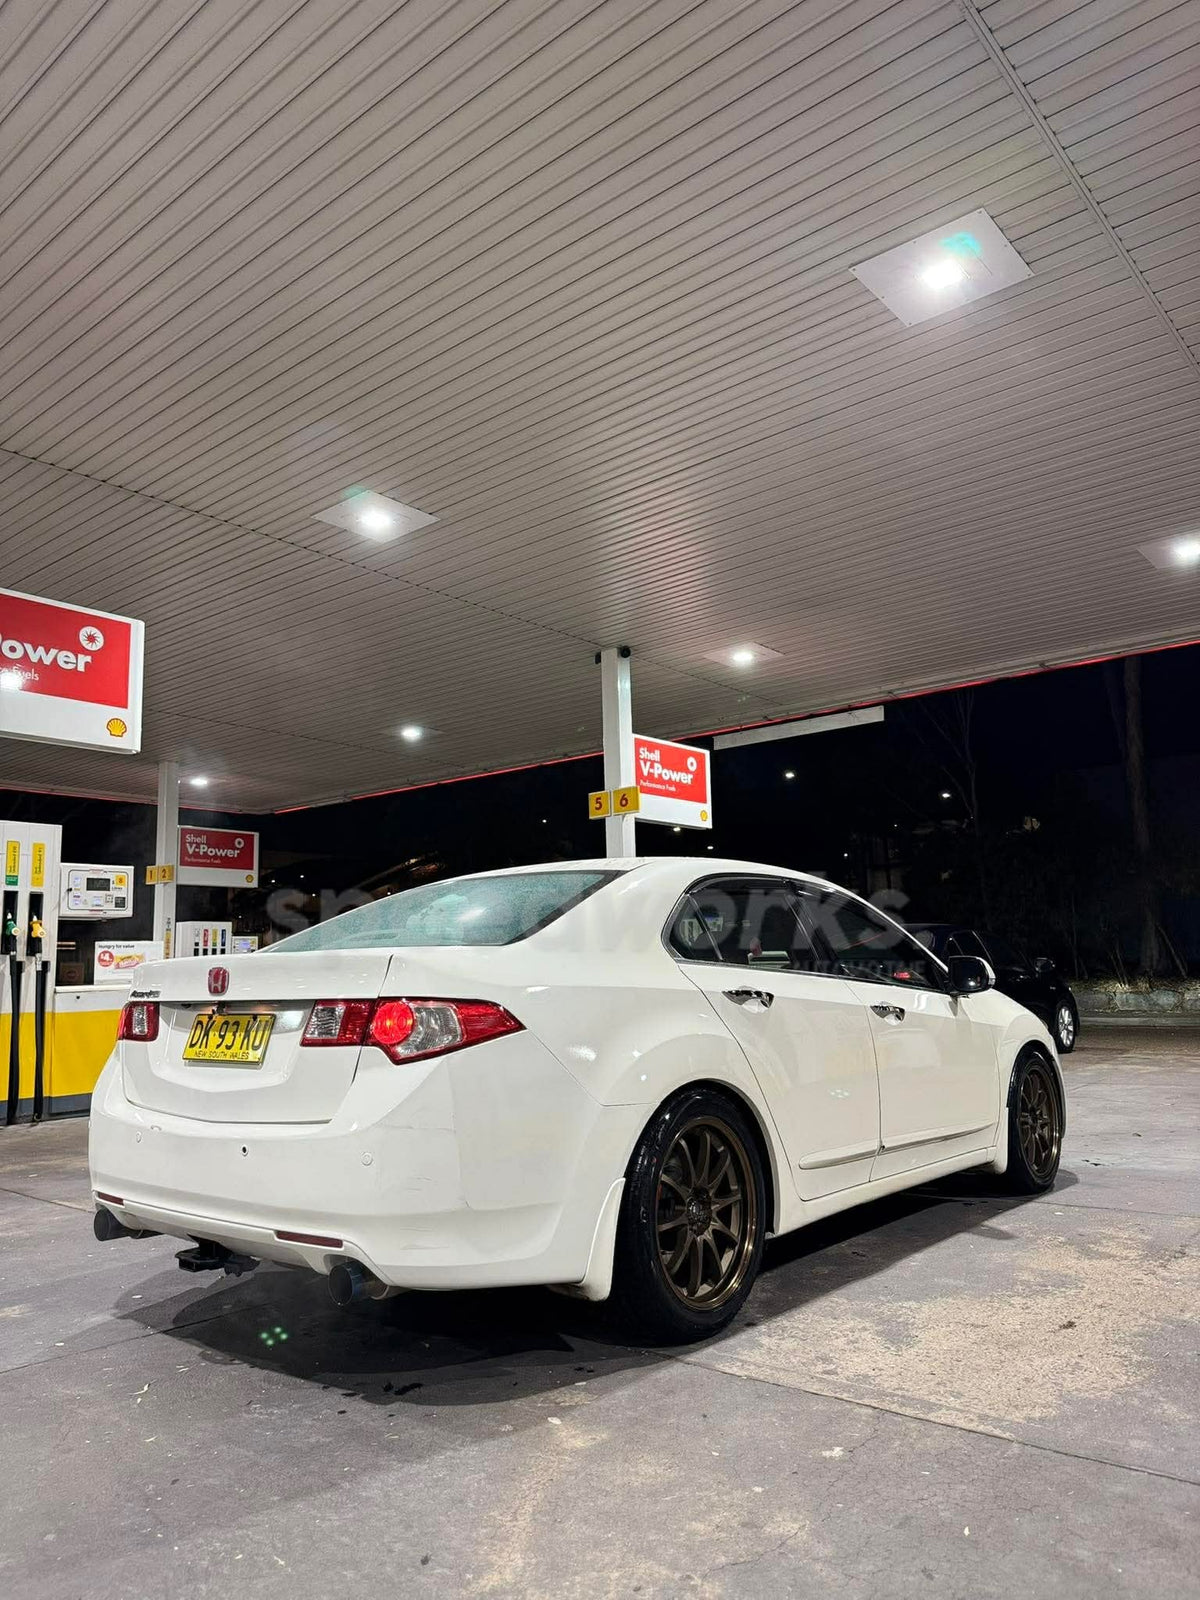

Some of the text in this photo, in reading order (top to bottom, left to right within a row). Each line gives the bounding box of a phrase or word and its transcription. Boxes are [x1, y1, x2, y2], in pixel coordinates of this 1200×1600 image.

[0, 633, 92, 672] ower
[639, 747, 660, 762] Shell
[640, 760, 694, 785] V-Power
[594, 797, 603, 811] 5
[619, 793, 629, 808] 6
[185, 833, 207, 844] Shell
[186, 843, 240, 858] V-Power
[149, 870, 154, 881] 1
[161, 868, 168, 879] 2
[189, 1019, 269, 1051] DK 93 KU
[208, 1050, 228, 1059] SOUTH
[229, 1051, 250, 1060] WALES
